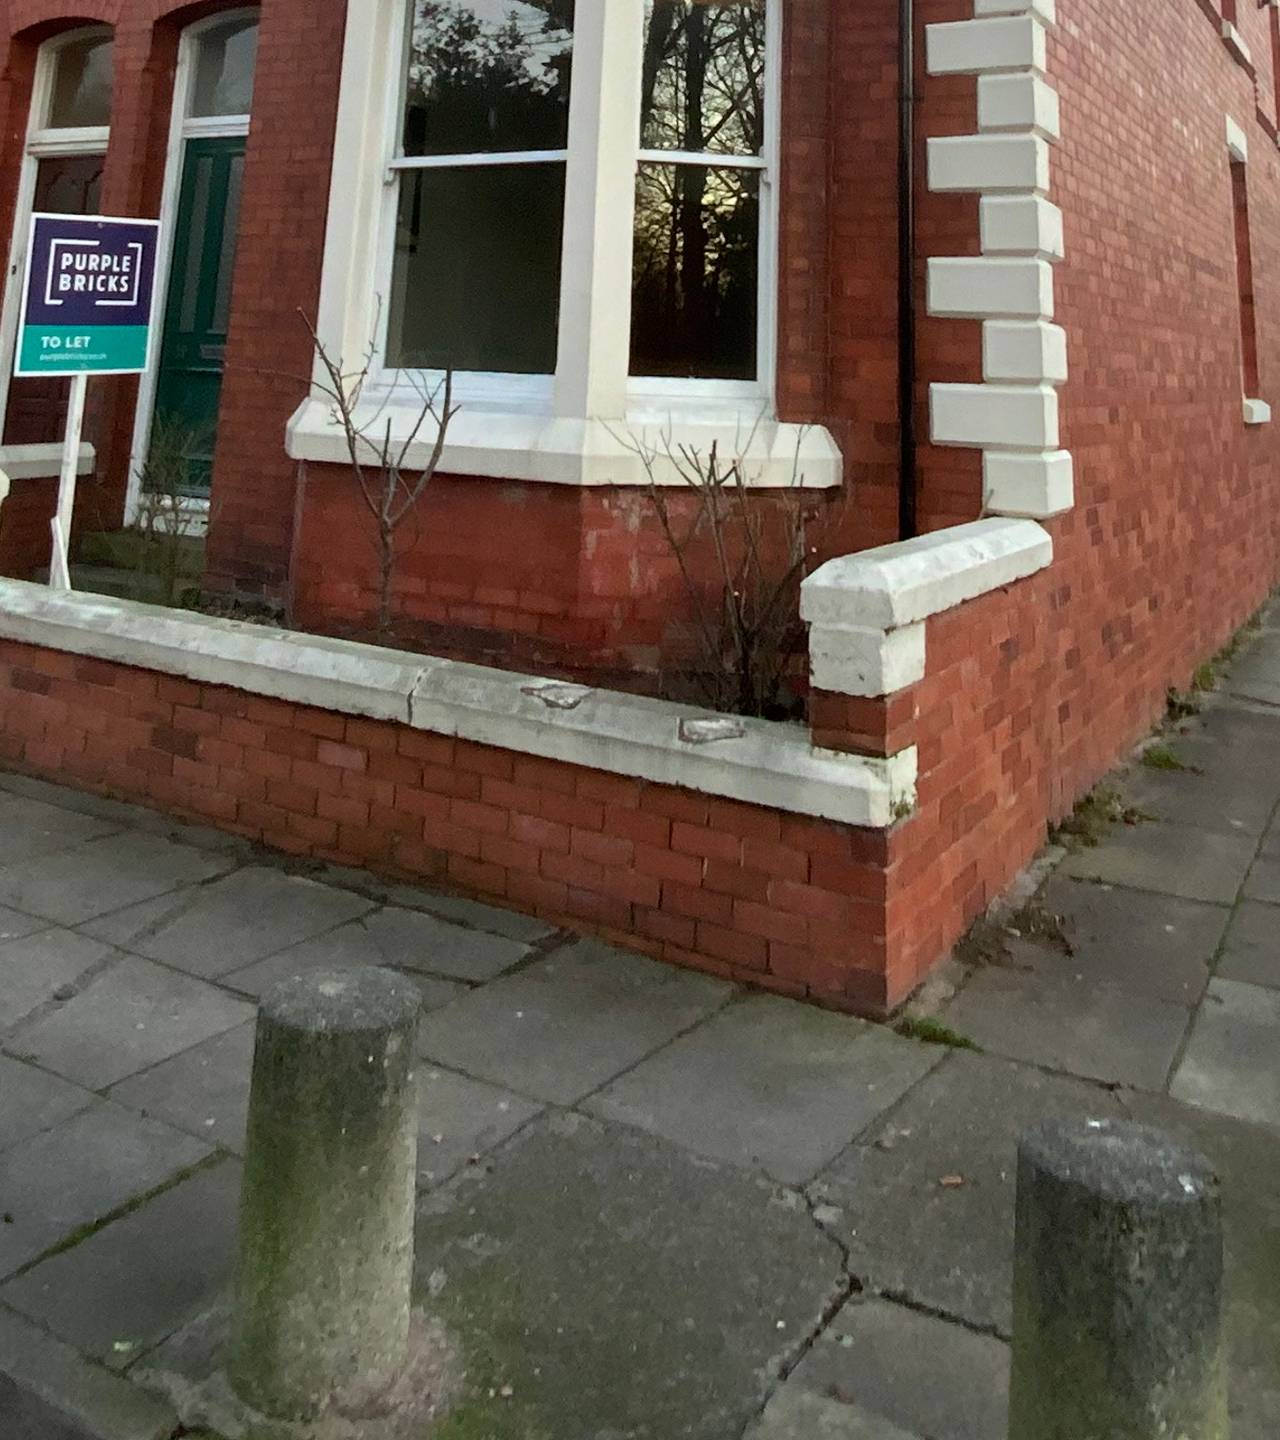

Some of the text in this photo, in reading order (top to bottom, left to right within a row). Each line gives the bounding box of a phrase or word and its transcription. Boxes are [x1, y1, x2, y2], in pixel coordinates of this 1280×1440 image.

[61, 253, 131, 272] PURPLE
[59, 275, 129, 292] BRICKS
[41, 336, 91, 348] TO LET
